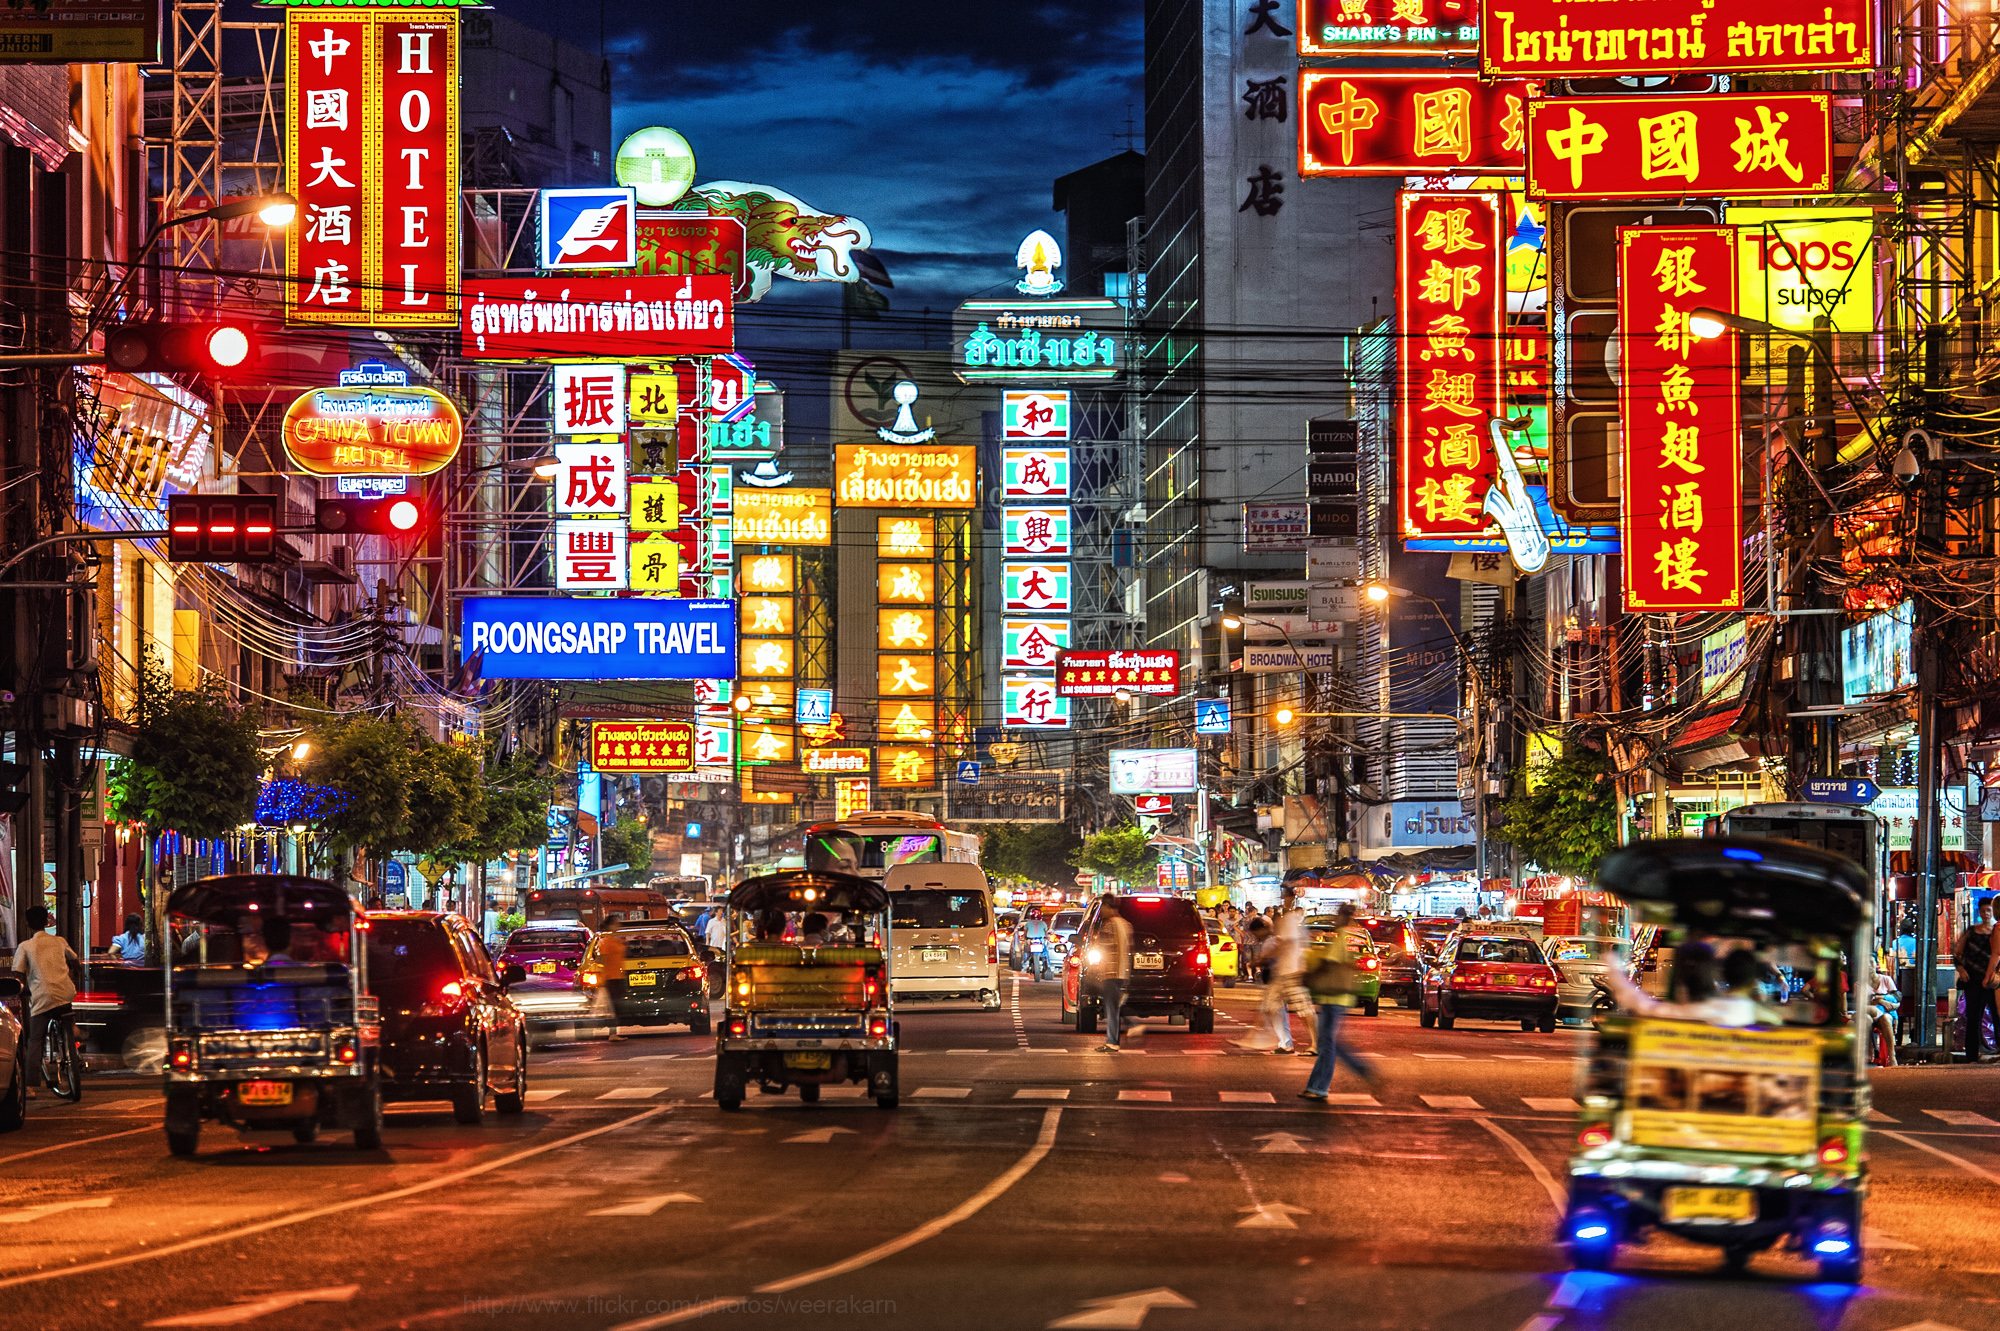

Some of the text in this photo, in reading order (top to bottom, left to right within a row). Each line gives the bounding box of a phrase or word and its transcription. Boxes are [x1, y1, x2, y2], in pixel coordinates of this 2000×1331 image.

[1323, 25, 1401, 41] SHARK'S
[1407, 27, 1437, 41] FIN
[1495, 7, 1857, 62] ไชน่าทาวน์ สกาล่า
[1545, 105, 1803, 189] 中國城
[305, 28, 356, 305] 中國大酒店
[397, 33, 434, 305] HOTEL
[1745, 235, 1854, 284] Tops
[1777, 288, 1853, 312] super
[470, 276, 724, 352] รุ่งทรัพย์การท่องเที่ยว
[996, 311, 1081, 328] ห้างขายทอง
[1414, 208, 1486, 526] 銀都魚翅酒樓
[293, 418, 453, 445] CHINA TOWN
[1651, 245, 1709, 595] 銀都魚翅酒樓
[1311, 432, 1354, 442] CITIZEN
[333, 446, 411, 469] HOTEL
[853, 447, 959, 467] ห้างขายทอง
[564, 375, 617, 583] 振成豐
[1312, 472, 1355, 483] RADO
[1317, 513, 1350, 523] MIDO
[1021, 400, 1054, 720] 和成興大金行
[1321, 596, 1347, 605] BALL
[472, 621, 726, 655] ROONGSARP TRAVEL
[1250, 653, 1333, 667] BROADWAY HOTE
[1406, 651, 1446, 666] MIDO
[1074, 685, 1093, 694] SOON
[597, 758, 690, 767] SO SENG HENG GOLDSMITH
[1810, 781, 1867, 798] เยาวราช 2
[1474, 924, 1516, 933] TAXI-METER
